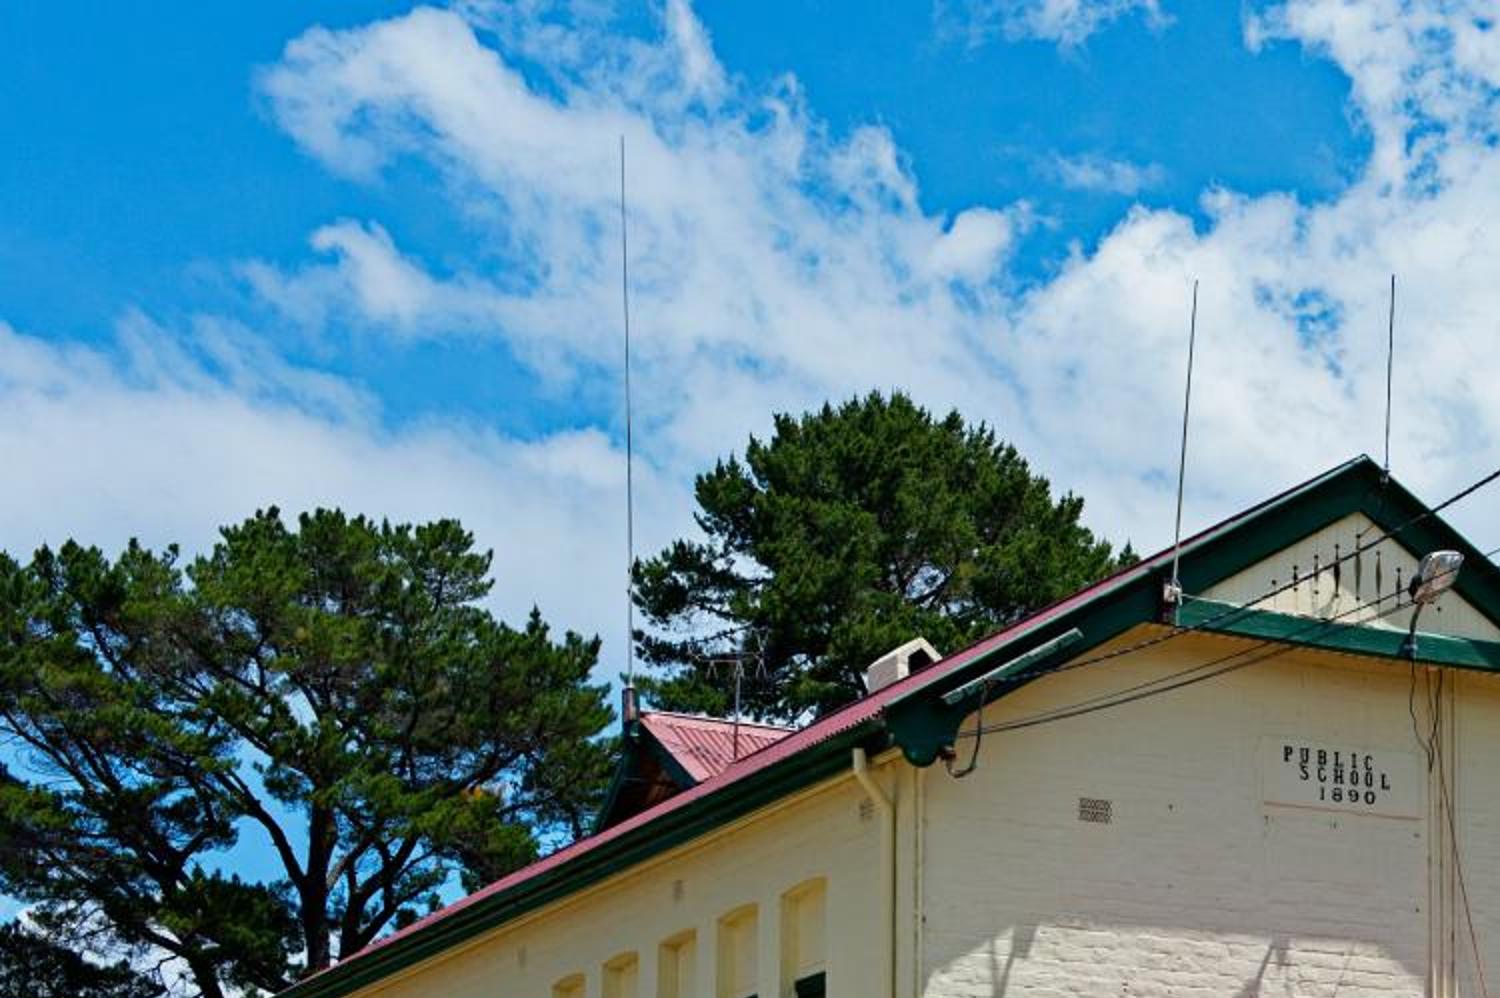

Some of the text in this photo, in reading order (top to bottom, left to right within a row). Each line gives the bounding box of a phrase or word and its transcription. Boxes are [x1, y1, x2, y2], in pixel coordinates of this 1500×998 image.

[1284, 745, 1373, 772] PUBLIC
[1300, 765, 1390, 790] SCHOOL
[1319, 787, 1376, 804] 1890
